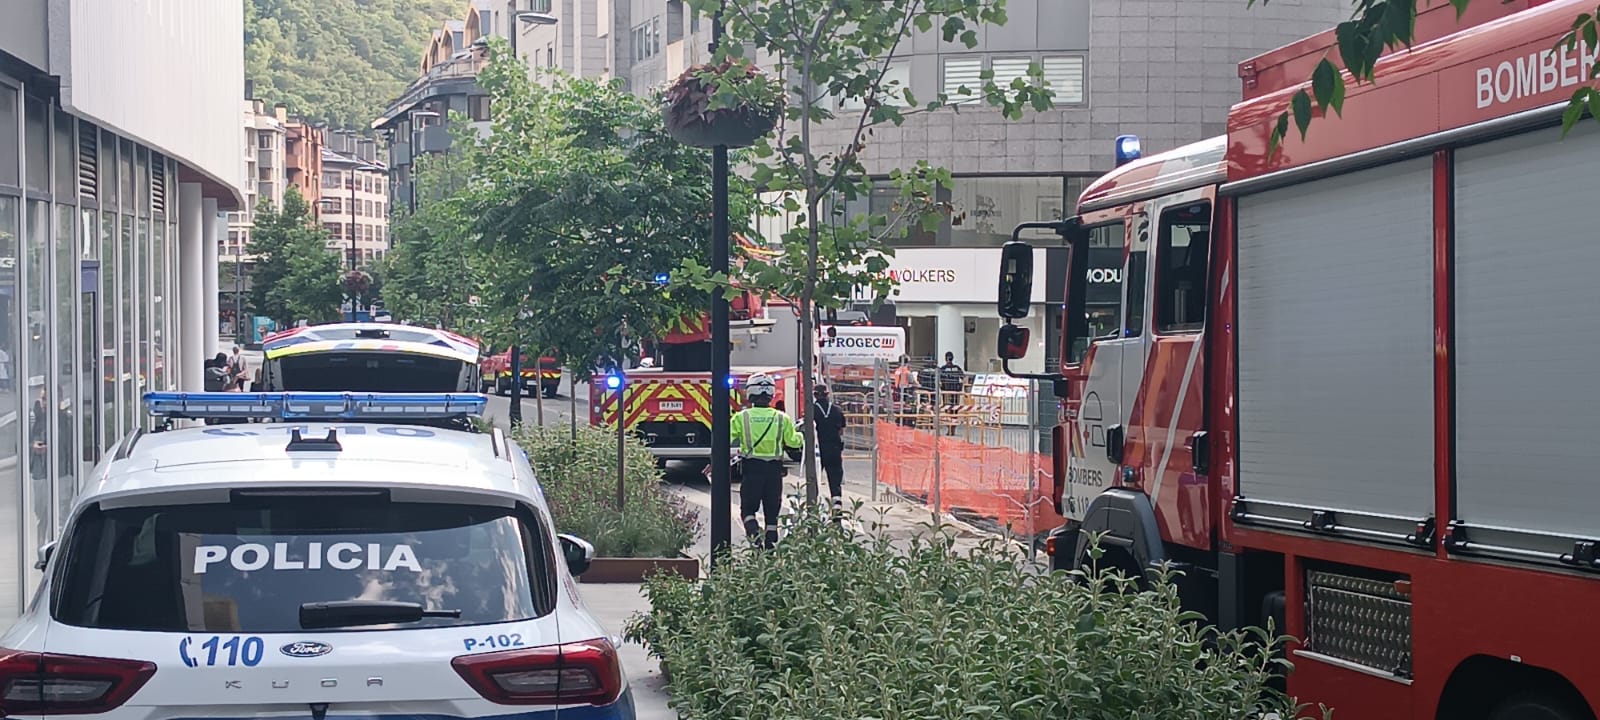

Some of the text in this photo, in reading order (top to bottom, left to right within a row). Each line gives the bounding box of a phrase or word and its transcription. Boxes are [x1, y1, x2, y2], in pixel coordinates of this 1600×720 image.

[193, 542, 422, 574] POLICIA
[202, 636, 264, 667] 110
[463, 633, 525, 651] P-102
